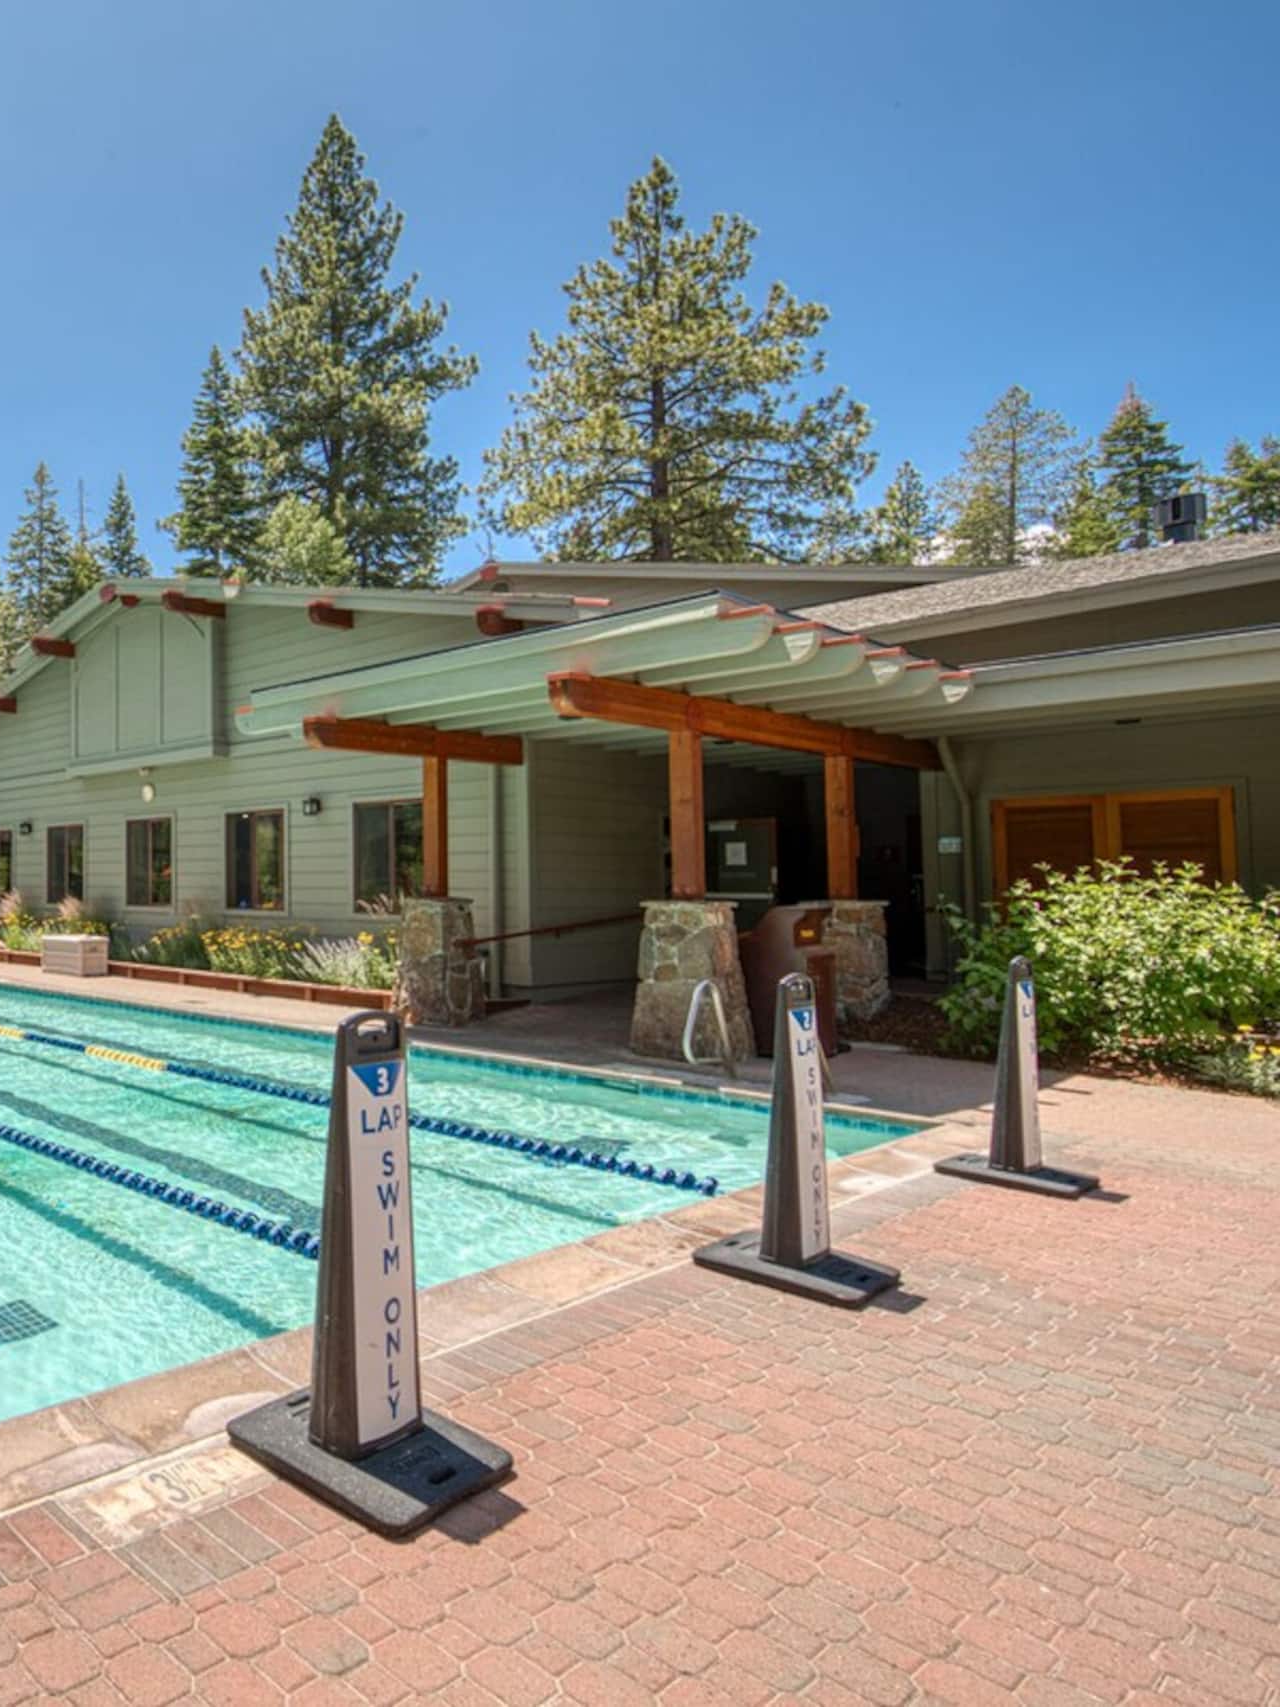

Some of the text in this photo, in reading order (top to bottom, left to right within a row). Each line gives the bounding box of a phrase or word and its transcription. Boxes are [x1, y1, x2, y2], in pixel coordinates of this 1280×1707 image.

[376, 1066, 390, 1094] 3
[361, 1104, 402, 1134] LAP
[377, 1151, 401, 1420] SWIM ONLY
